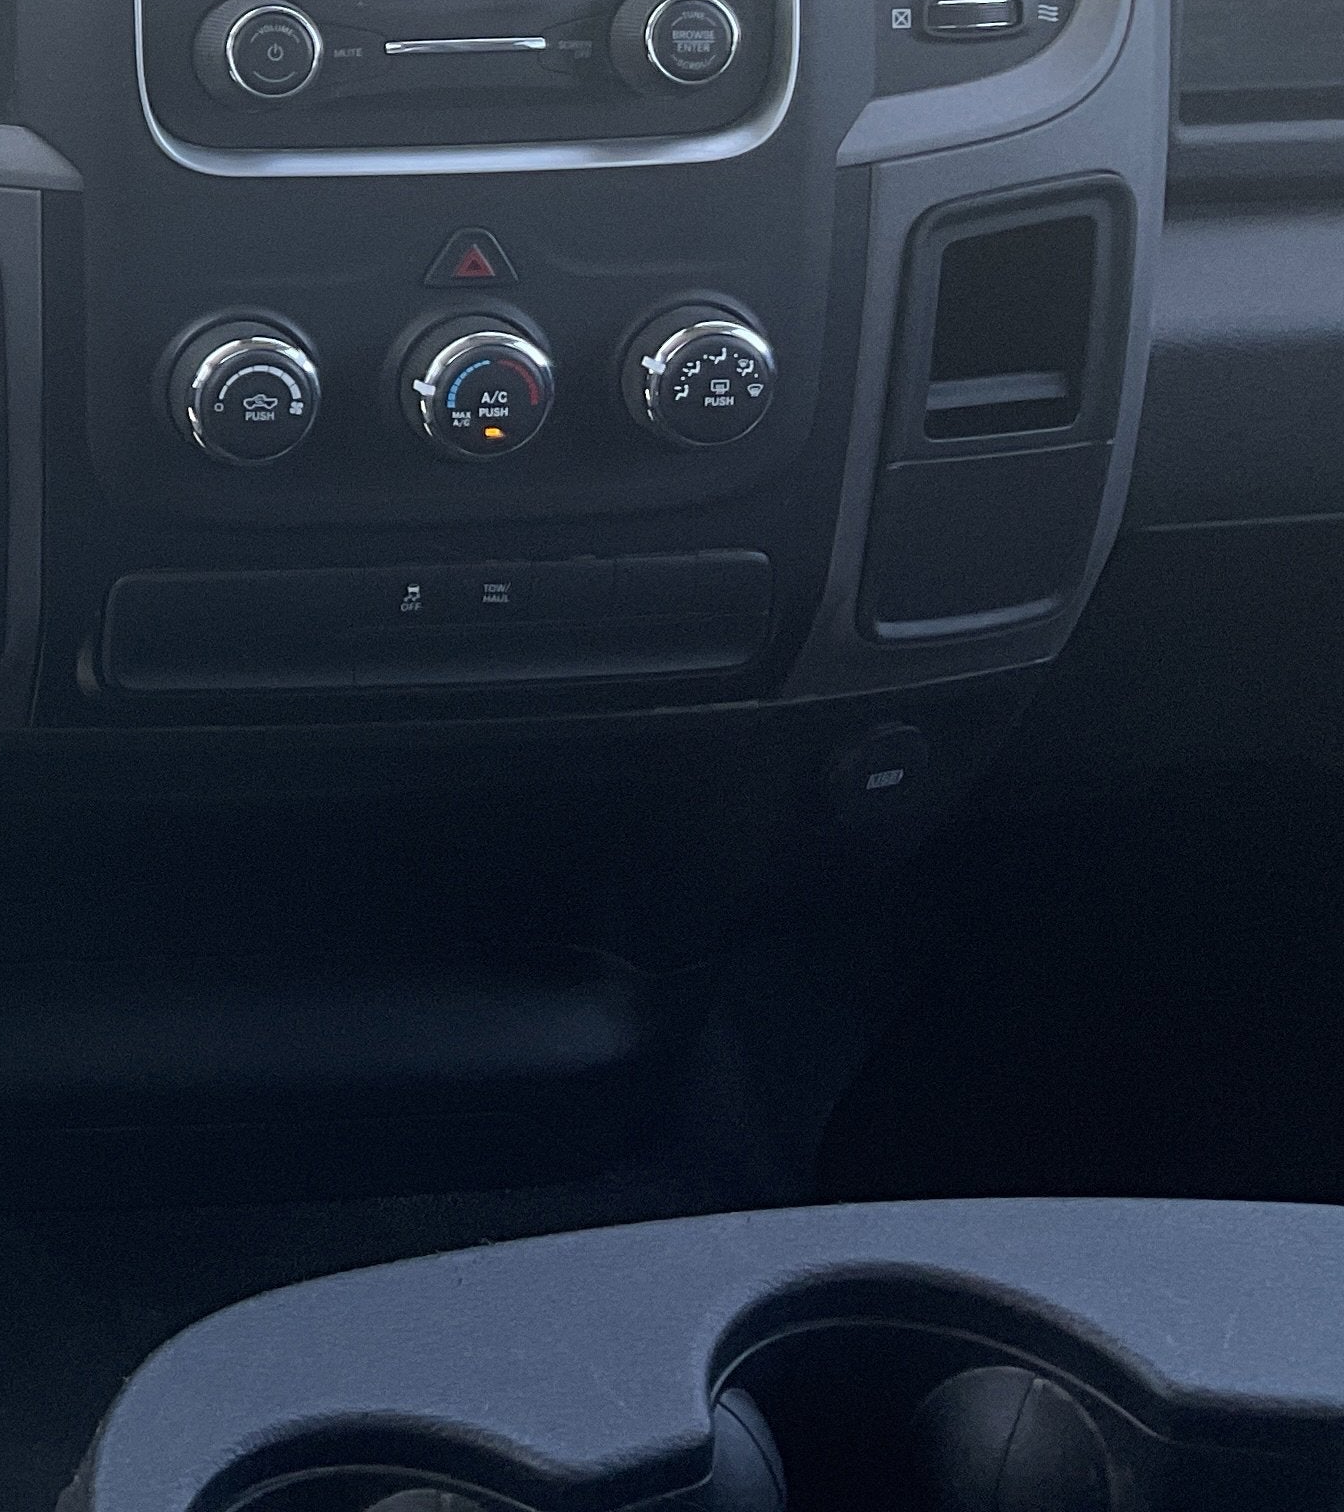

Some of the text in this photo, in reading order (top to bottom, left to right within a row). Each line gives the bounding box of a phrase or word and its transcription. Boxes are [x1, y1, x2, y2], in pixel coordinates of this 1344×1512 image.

[333, 48, 362, 58] MUTE
[676, 42, 711, 53] ENTER
[481, 390, 508, 404] A/C
[704, 396, 734, 407] PUSH
[245, 411, 275, 421] PUSH
[452, 411, 472, 419] MAX
[478, 406, 509, 418] PUSH
[400, 601, 423, 612] OFF
